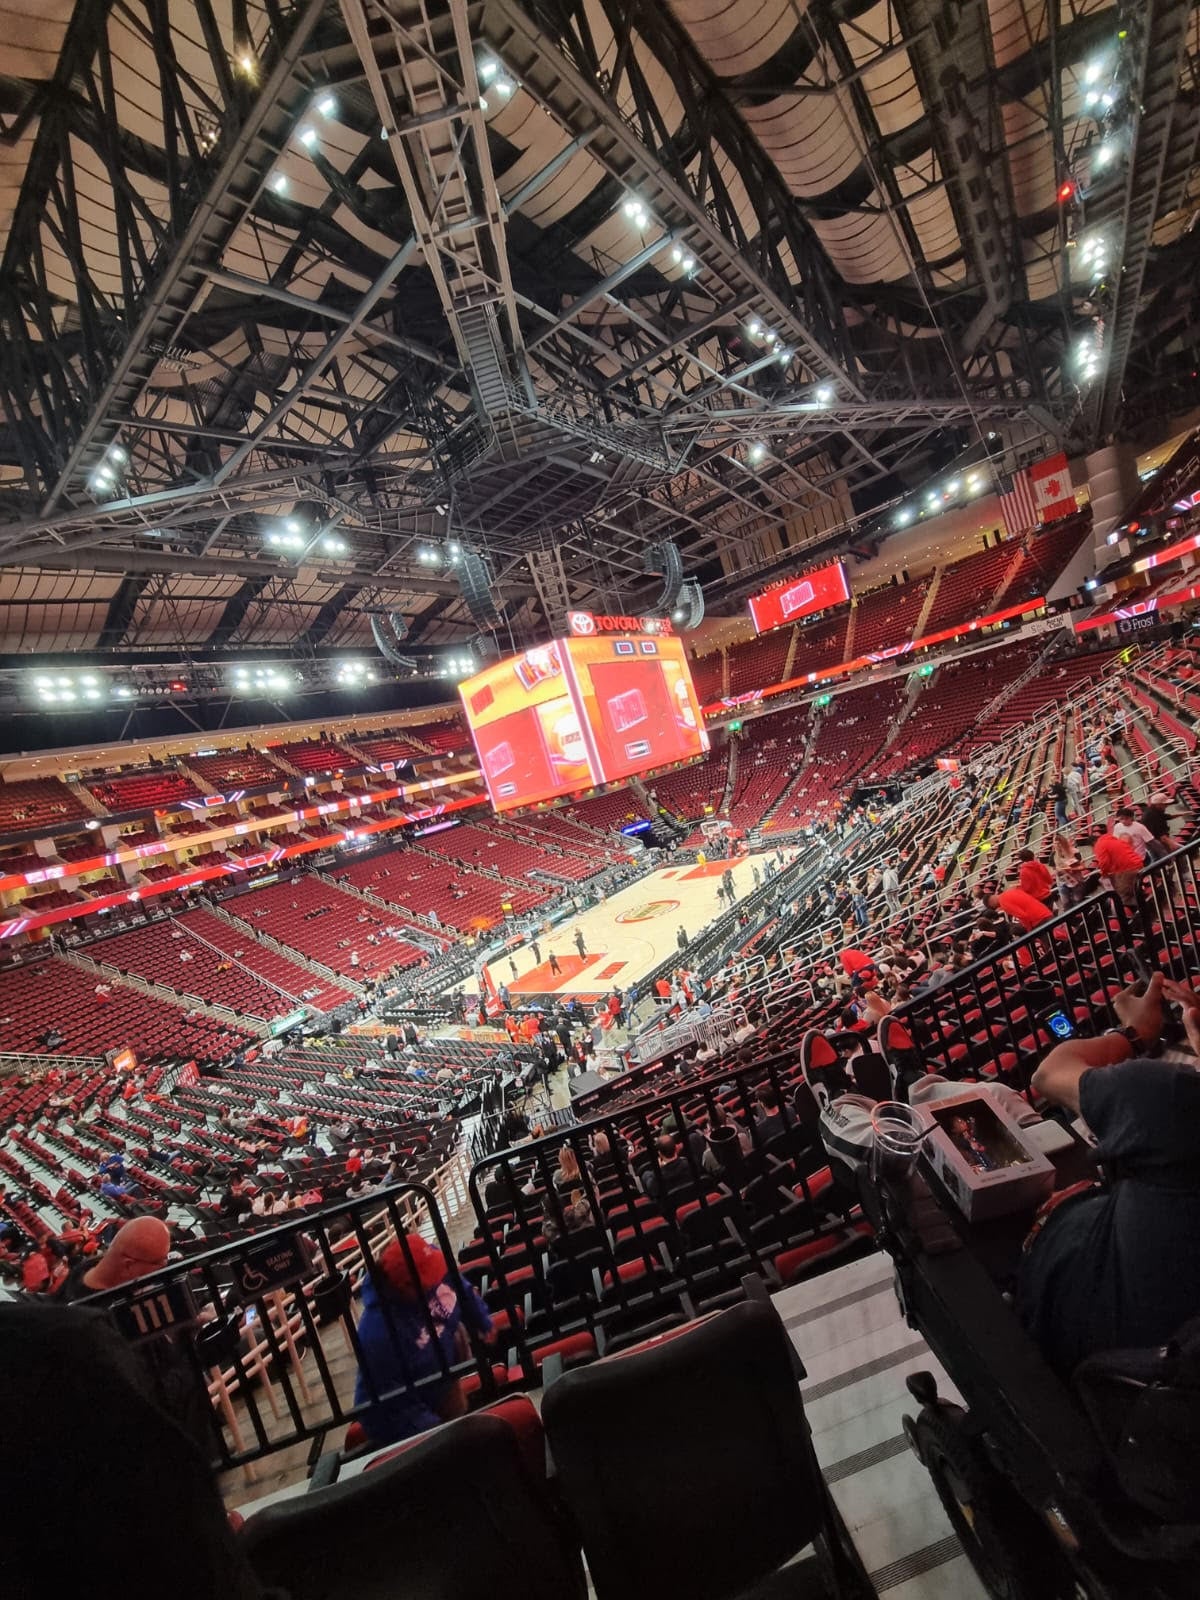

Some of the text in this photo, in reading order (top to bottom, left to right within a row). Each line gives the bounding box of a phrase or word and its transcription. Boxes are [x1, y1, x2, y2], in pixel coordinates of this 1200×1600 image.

[594, 615, 641, 631] TOYOTA
[1132, 615, 1154, 631] Frost
[266, 1250, 294, 1266] SEATING
[273, 1259, 291, 1271] ONLY
[130, 1294, 175, 1334] 111
